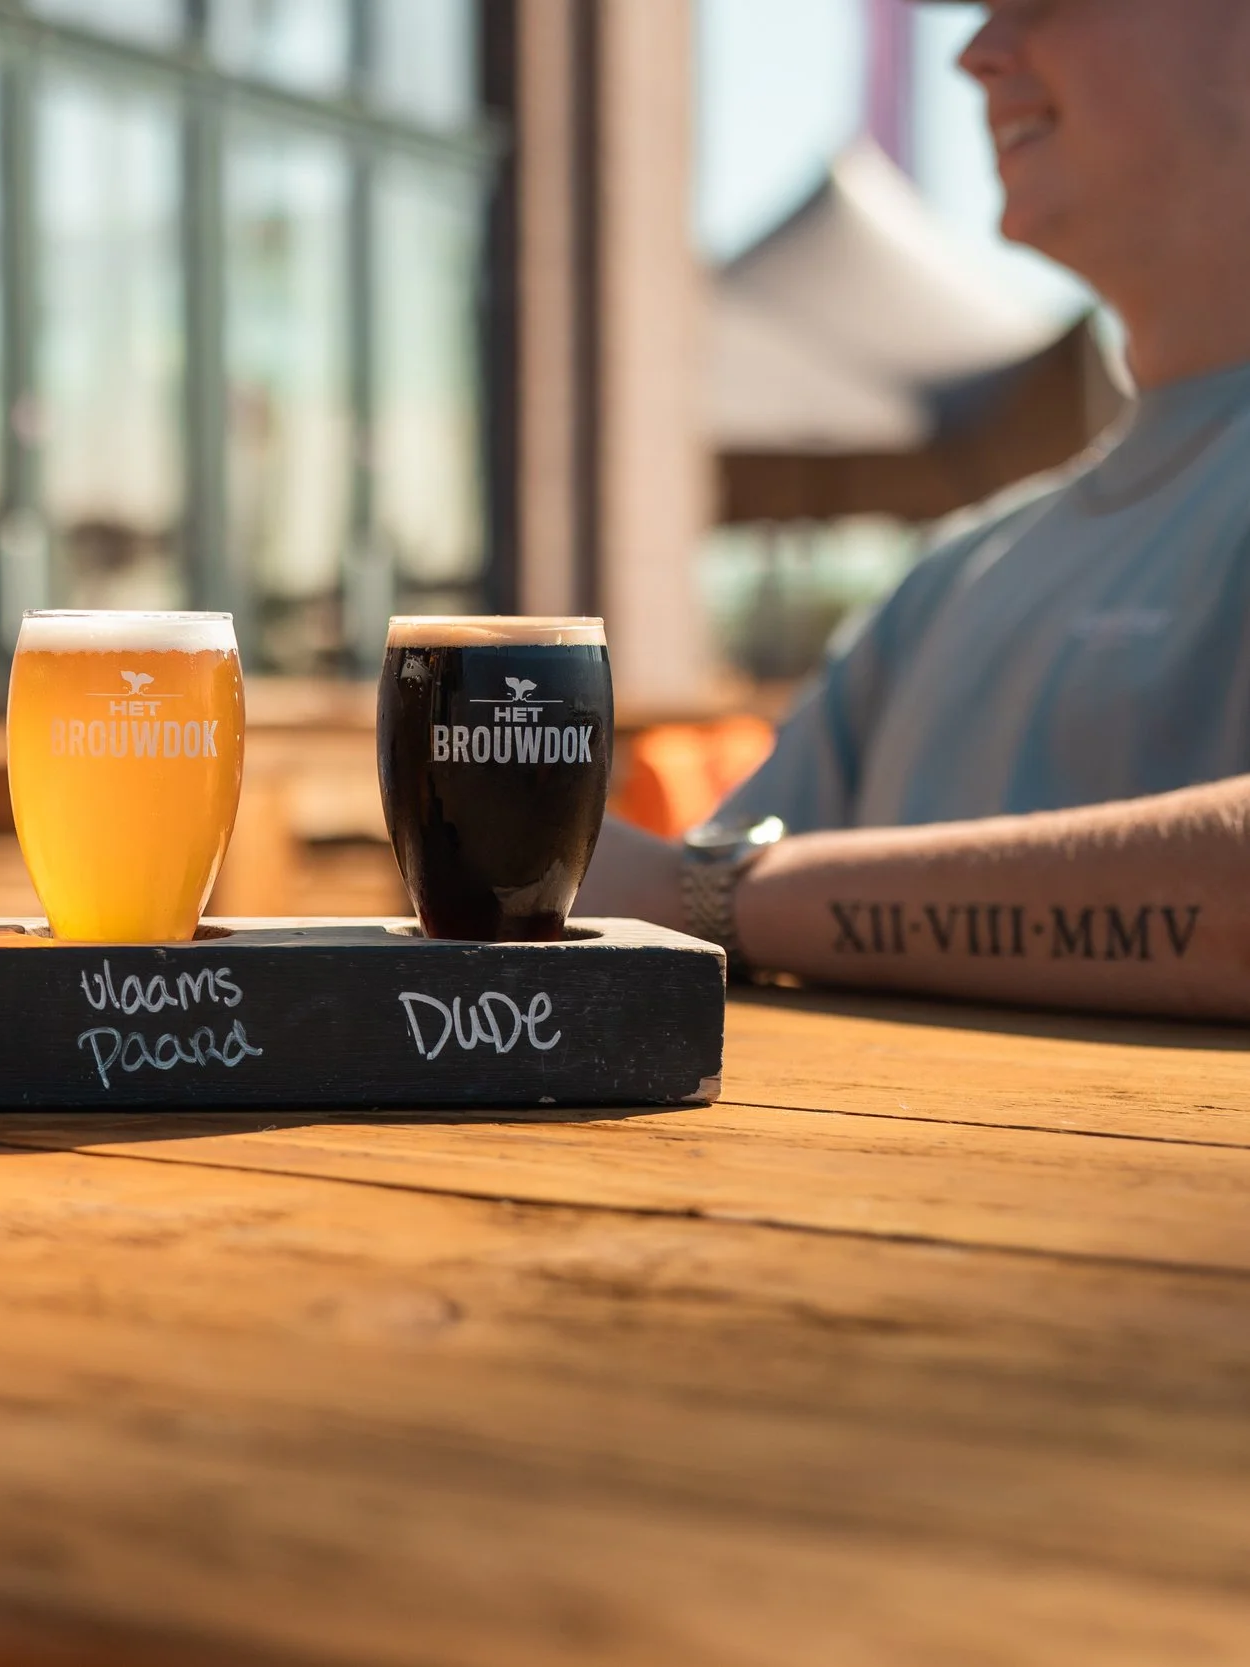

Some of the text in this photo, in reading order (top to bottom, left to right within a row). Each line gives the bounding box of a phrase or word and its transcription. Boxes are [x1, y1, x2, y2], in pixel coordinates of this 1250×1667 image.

[109, 700, 162, 717] HET
[494, 706, 543, 723] HET
[50, 717, 219, 759] BROUWDOK
[433, 725, 593, 764] BROUWDOK
